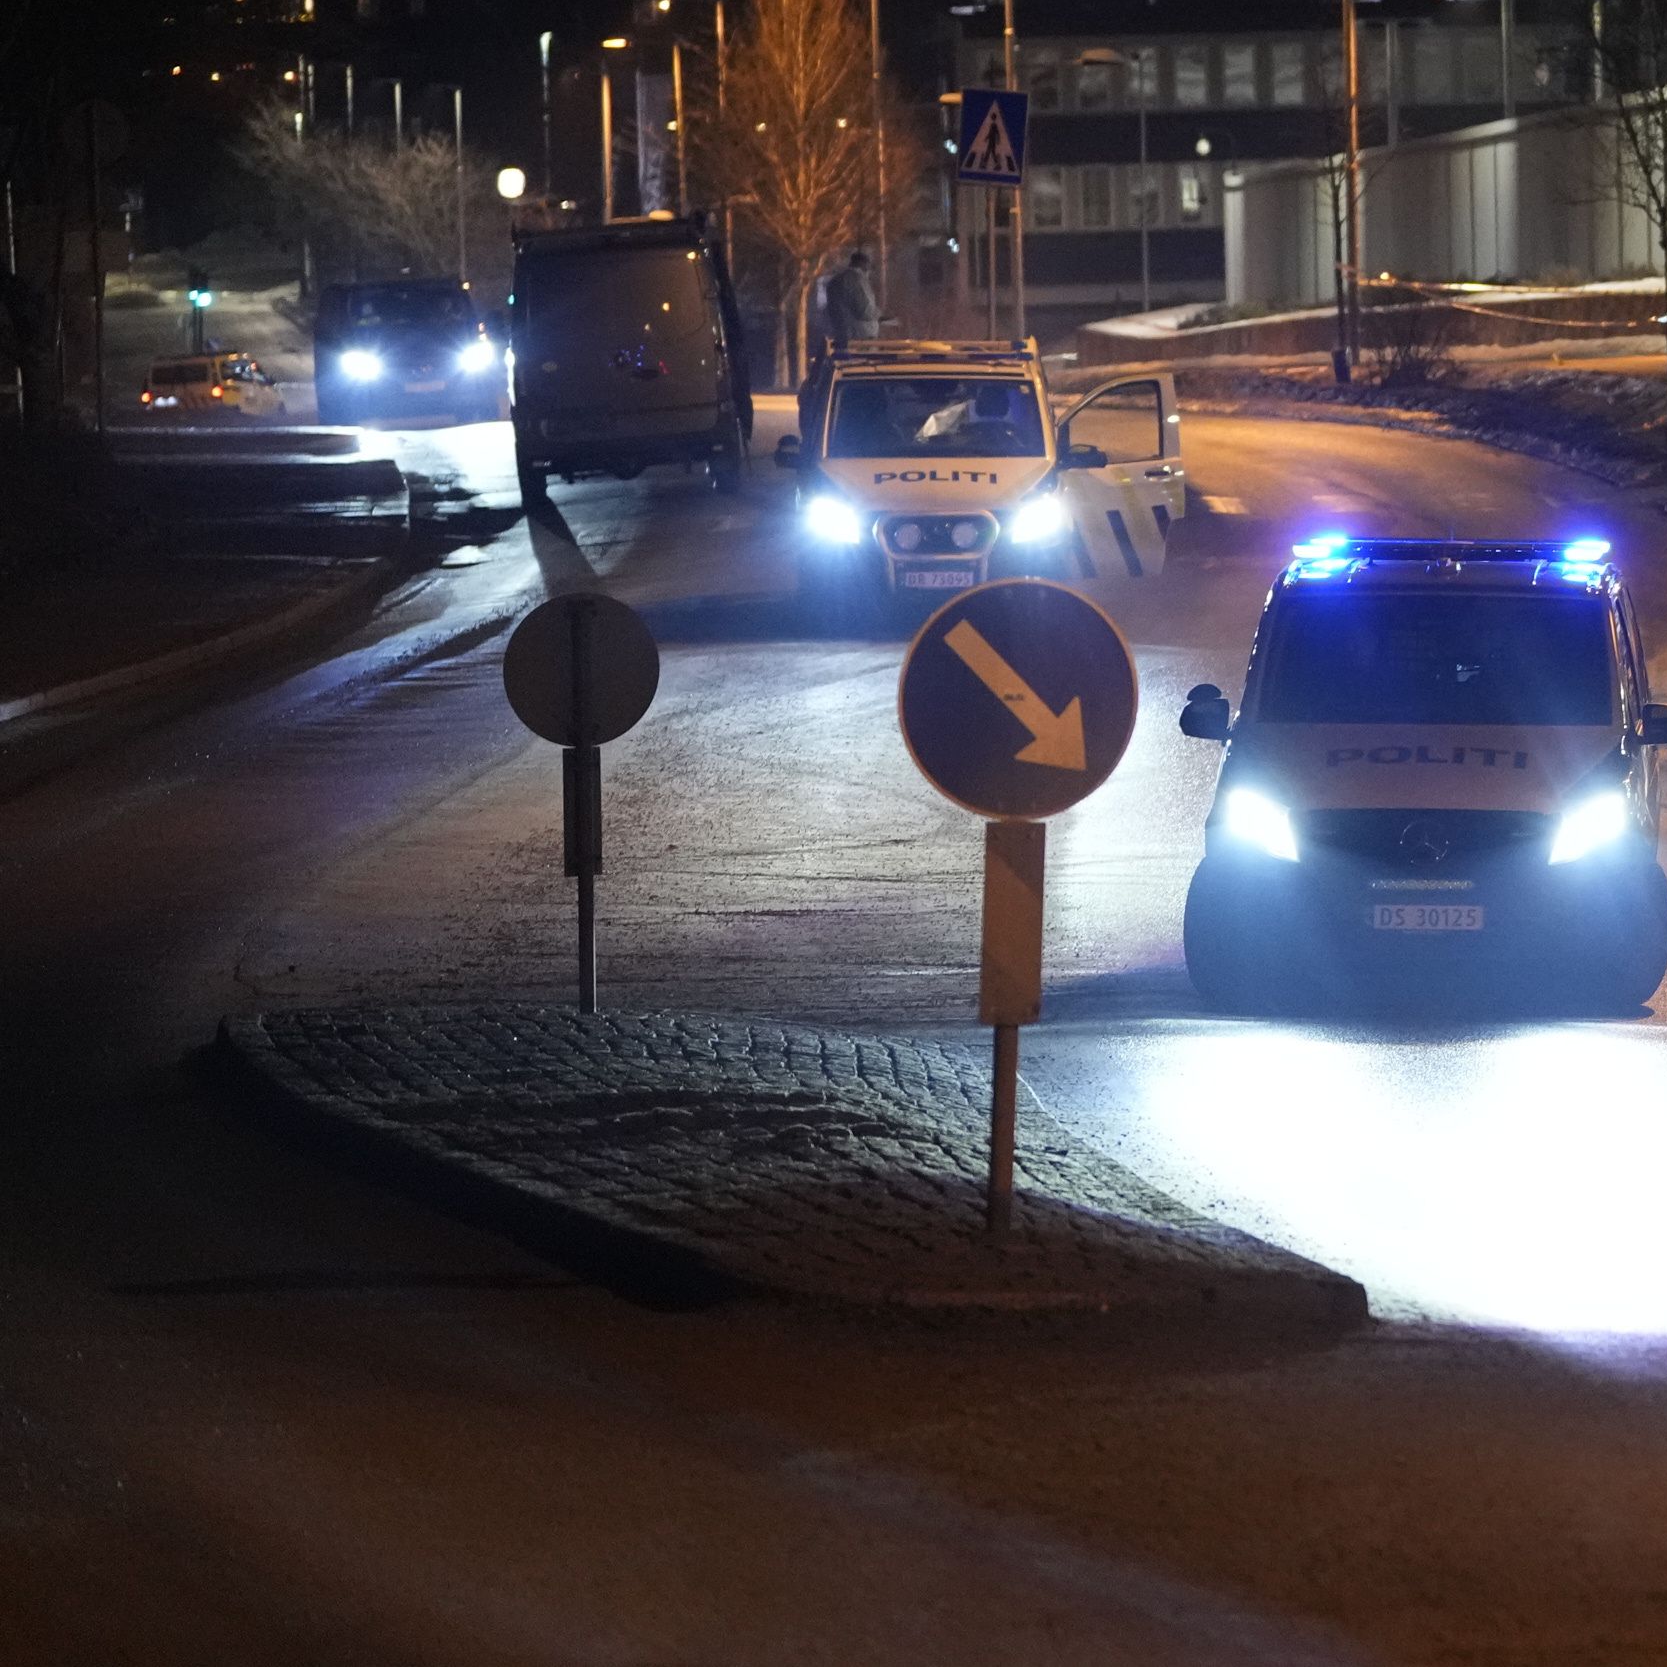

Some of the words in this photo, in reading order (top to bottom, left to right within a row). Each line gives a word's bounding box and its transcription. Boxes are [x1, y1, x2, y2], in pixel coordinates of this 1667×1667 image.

[874, 470, 997, 484] POLITI
[1326, 746, 1528, 768] POLITI
[1380, 908, 1406, 926] DS
[1416, 908, 1477, 927] 30125
